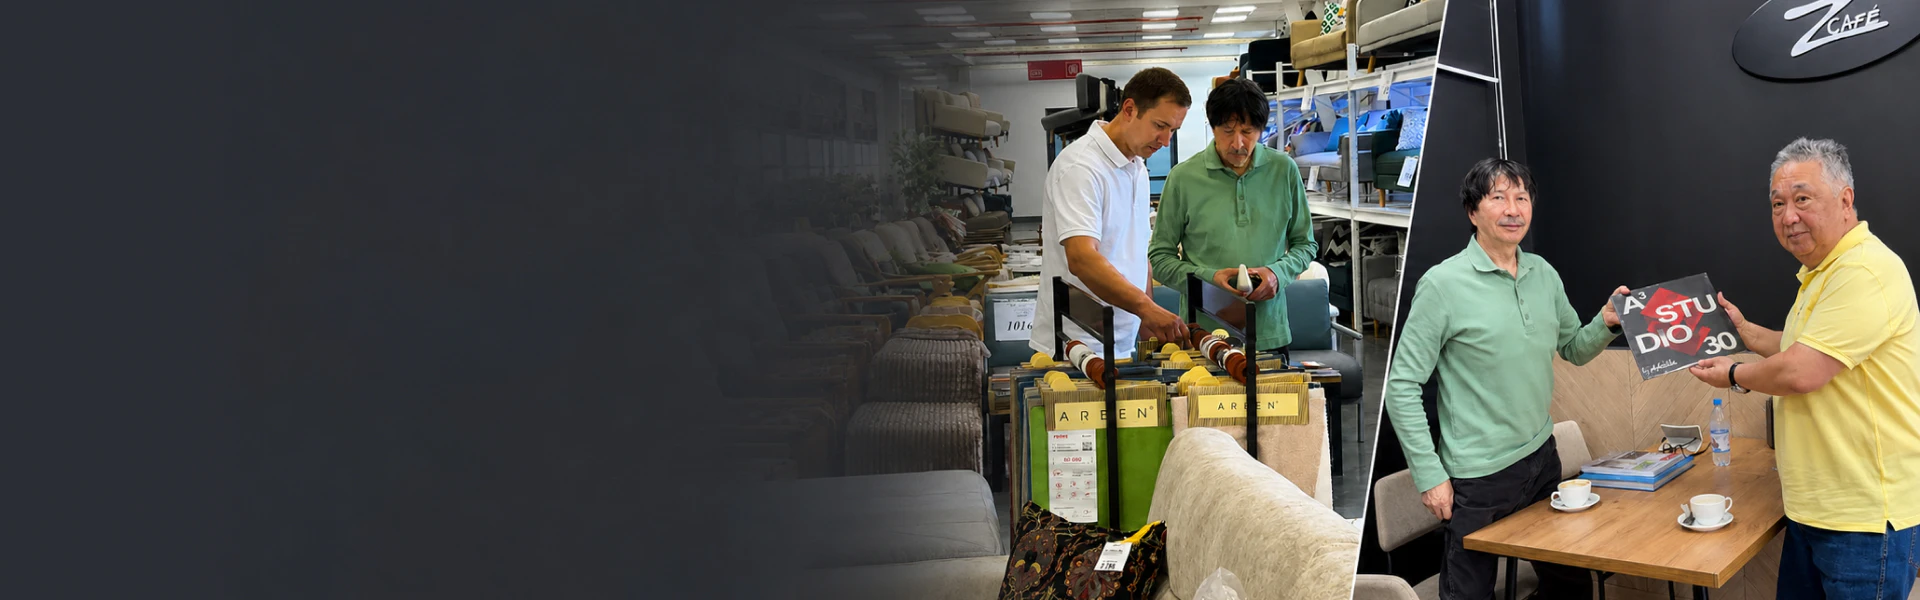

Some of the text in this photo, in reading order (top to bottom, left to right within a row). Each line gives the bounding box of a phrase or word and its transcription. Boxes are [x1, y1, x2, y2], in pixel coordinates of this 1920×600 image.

[1783, 0, 1889, 57] Z CAFÉ
[1655, 293, 1717, 323] STU
[1635, 324, 1693, 354] DIO
[1703, 331, 1738, 355] 30
